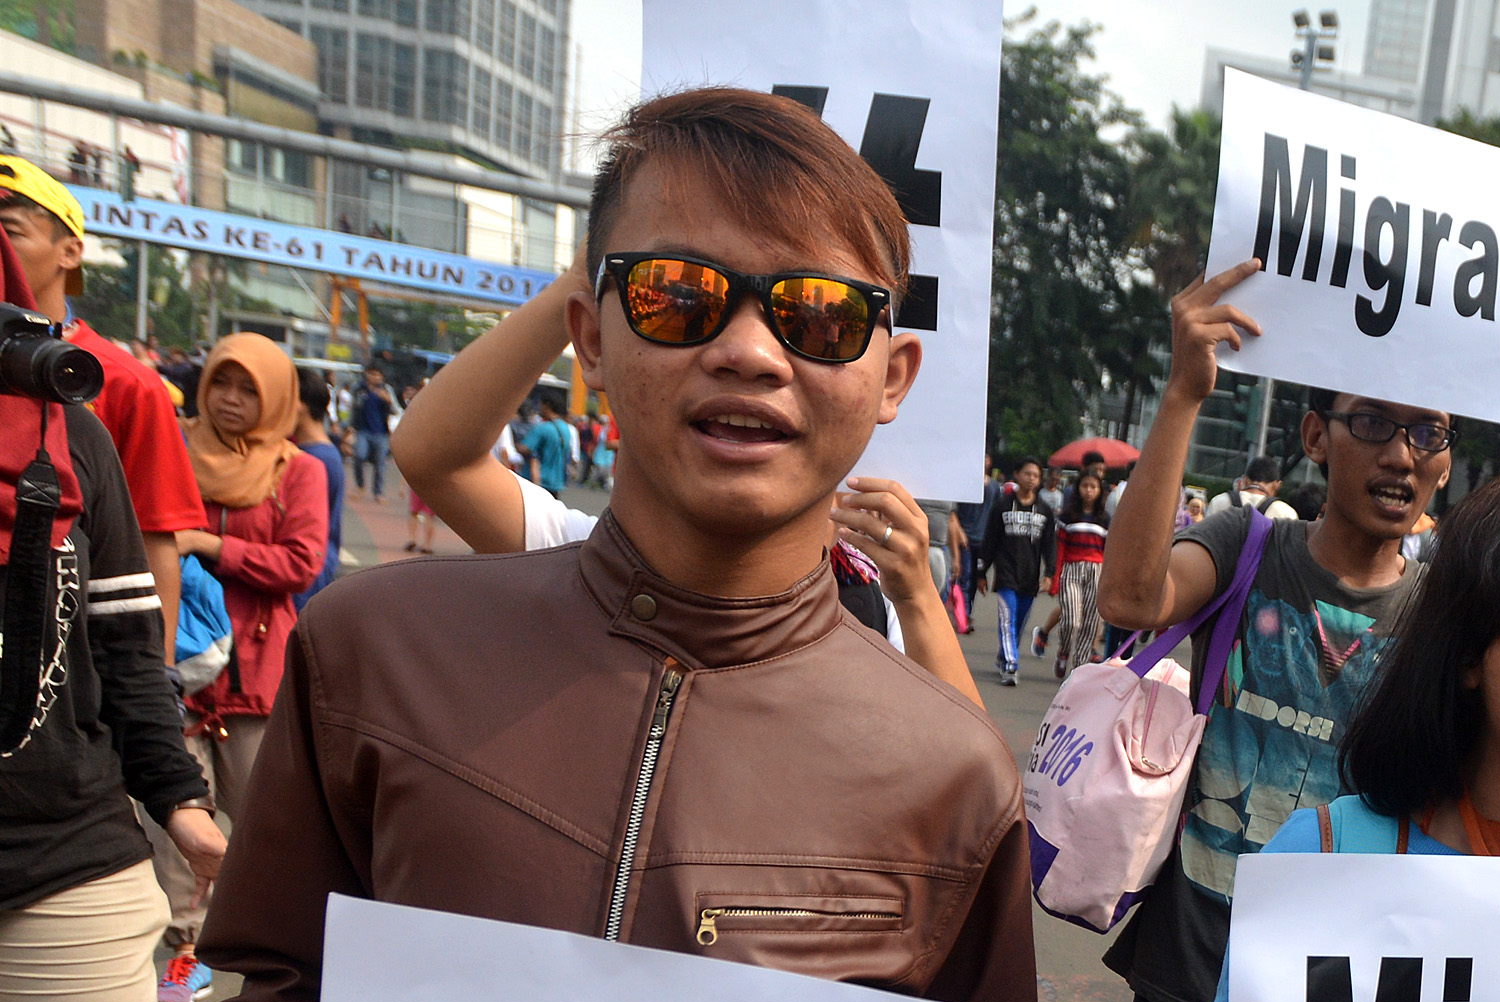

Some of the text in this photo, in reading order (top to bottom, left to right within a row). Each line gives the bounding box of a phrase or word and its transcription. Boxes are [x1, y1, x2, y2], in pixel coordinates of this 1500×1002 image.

[84, 202, 549, 297] INTAS KE-61 TAHUN 201
[1038, 724, 1094, 787] 2016
